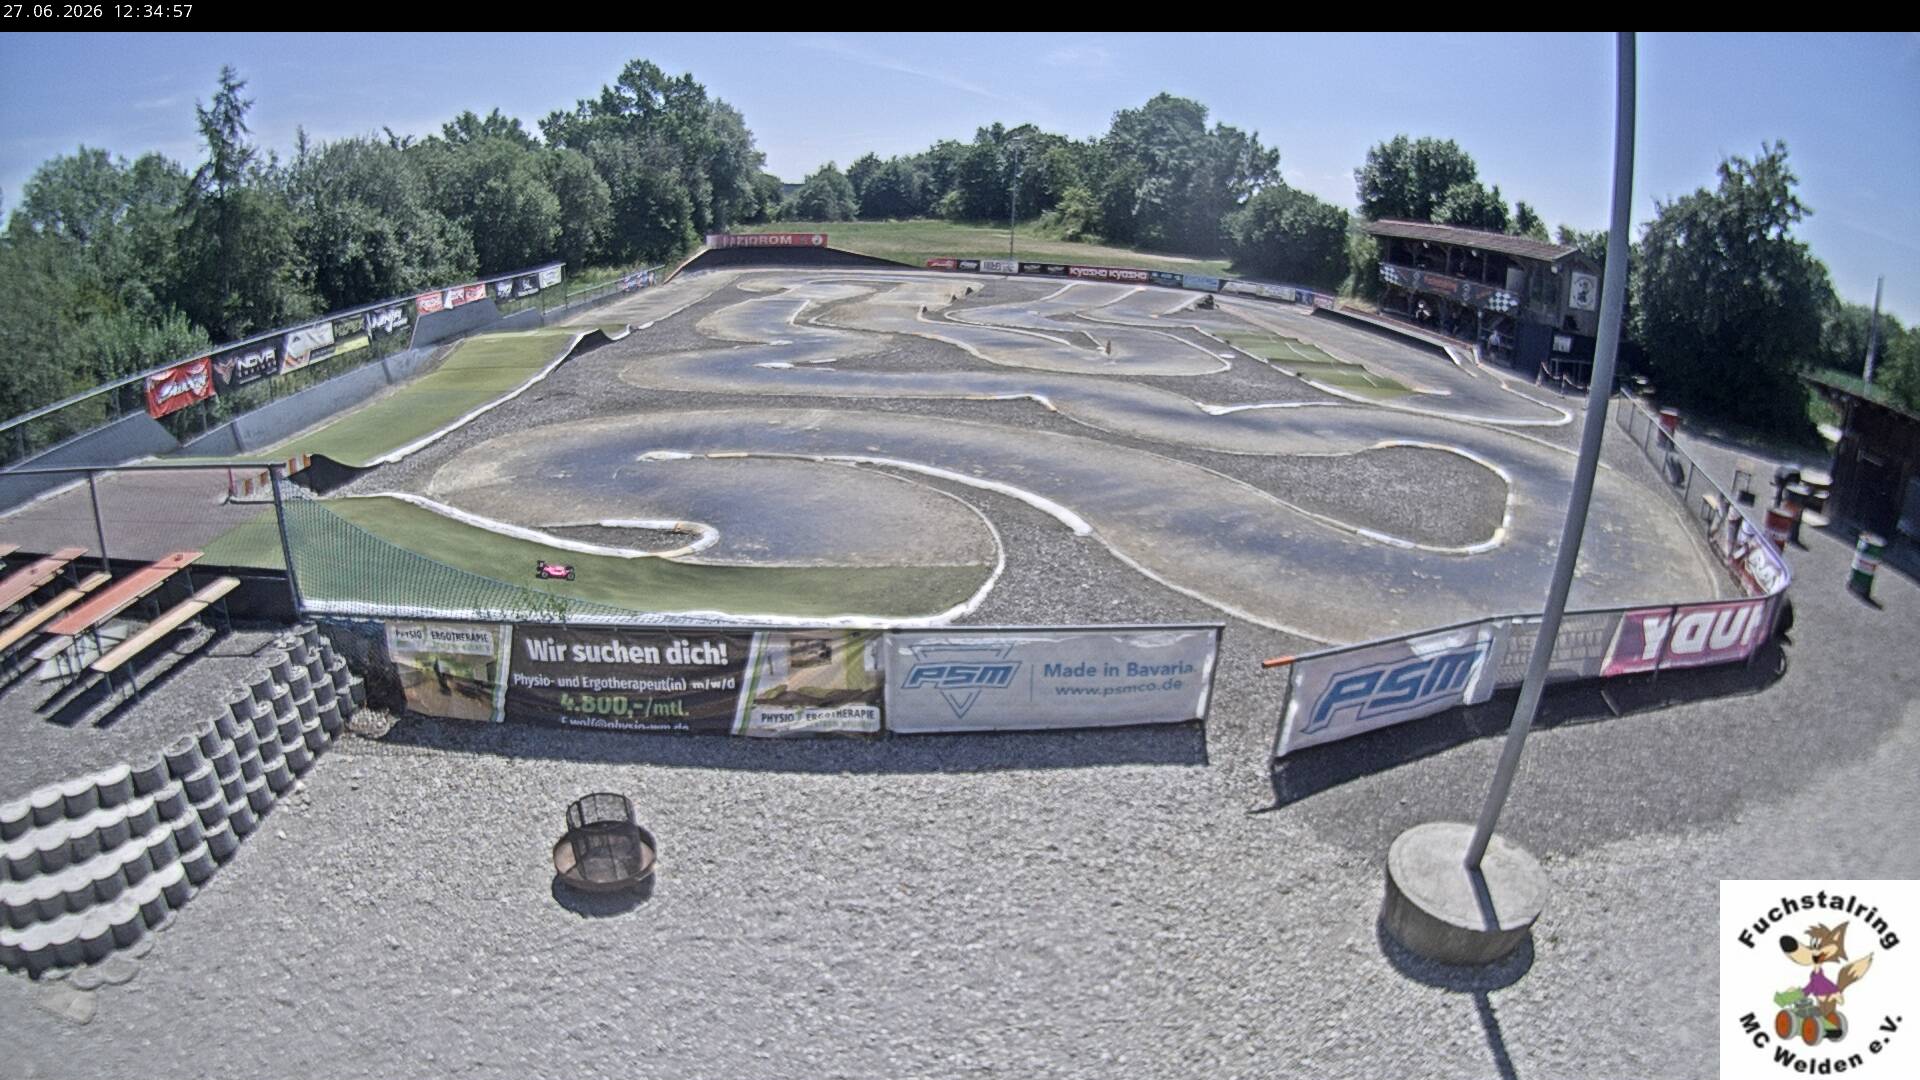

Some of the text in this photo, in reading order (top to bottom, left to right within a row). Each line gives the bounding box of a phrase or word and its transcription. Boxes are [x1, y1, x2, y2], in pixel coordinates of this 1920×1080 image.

[237, 347, 276, 372] NOVA
[526, 638, 729, 666] Wir suchen dich!
[906, 663, 1018, 688] PSM
[1044, 660, 1193, 678] Made in Bavaria
[513, 673, 735, 692] Physio- und Ergotherapeut(in) m/w/d
[1055, 678, 1183, 697] www.psmco.de
[1310, 646, 1489, 726] PSM
[761, 713, 795, 723] PHYSIO
